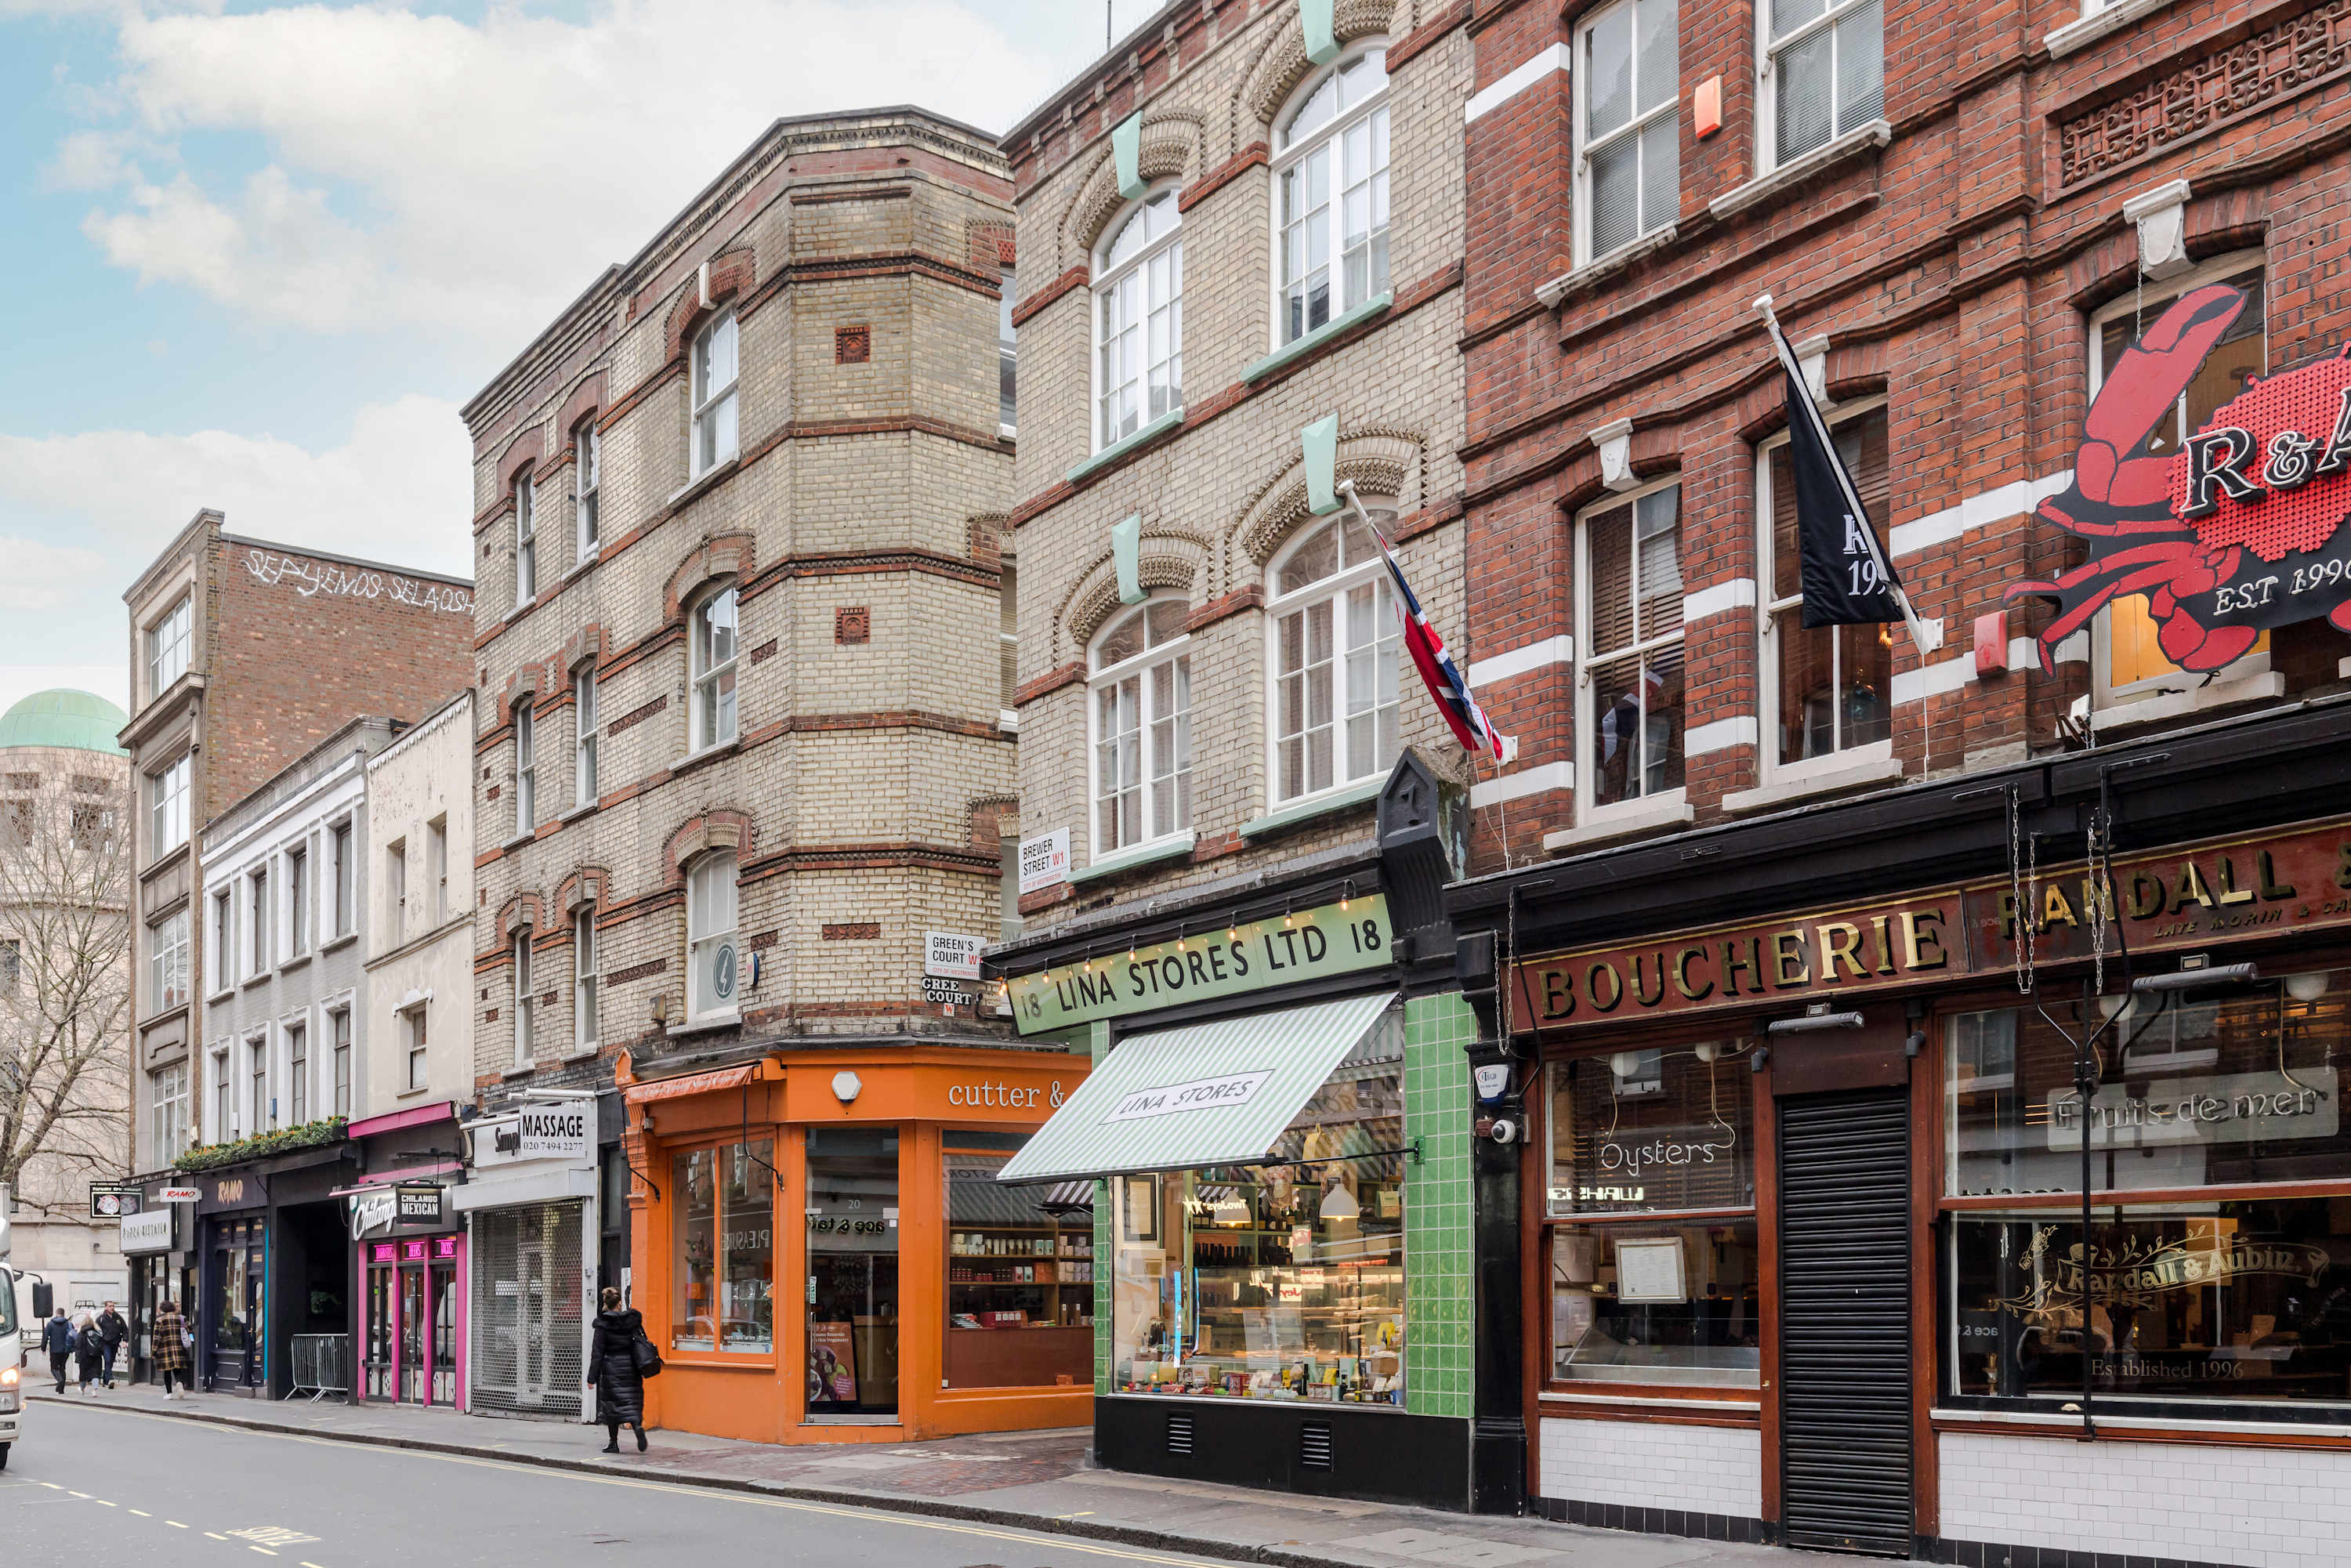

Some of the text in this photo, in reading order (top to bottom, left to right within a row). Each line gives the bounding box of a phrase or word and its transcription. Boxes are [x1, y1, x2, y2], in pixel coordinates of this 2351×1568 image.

[1848, 559, 1886, 596] 19
[2213, 575, 2279, 616] EST
[1023, 838, 1053, 860] BREWER
[1023, 849, 1065, 876] STREET W1
[1996, 849, 2296, 939] RANDALL
[2154, 921, 2198, 937] LATE
[2209, 908, 2283, 930] MORIN
[2298, 904, 2310, 918] &
[933, 936, 974, 951] GREEN'S
[933, 951, 965, 964] COURT
[1021, 919, 1382, 1019] 18 LINA STORES LTD 18
[1538, 908, 1946, 1019] BOUCHERIE
[922, 977, 959, 991] GREE
[951, 969, 980, 978] WESTMINSTE
[926, 990, 972, 1005] COURT
[948, 1081, 1065, 1109] cutter &
[1118, 1078, 1255, 1116] LINA STORES
[2056, 1087, 2318, 1130] Fruits de mer
[523, 1115, 583, 1137] MASSAGE
[523, 1142, 583, 1150] 020 7494 2277
[1601, 1138, 1715, 1178] Oysters
[166, 1190, 196, 1199] RAMO
[218, 1179, 244, 1204] RAMO
[401, 1203, 439, 1215] MEXICAN
[848, 1199, 860, 1209] 20
[353, 1197, 397, 1241] Chilang
[2183, 1257, 2204, 1280] &
[2091, 1360, 2244, 1379] Esablished 1996
